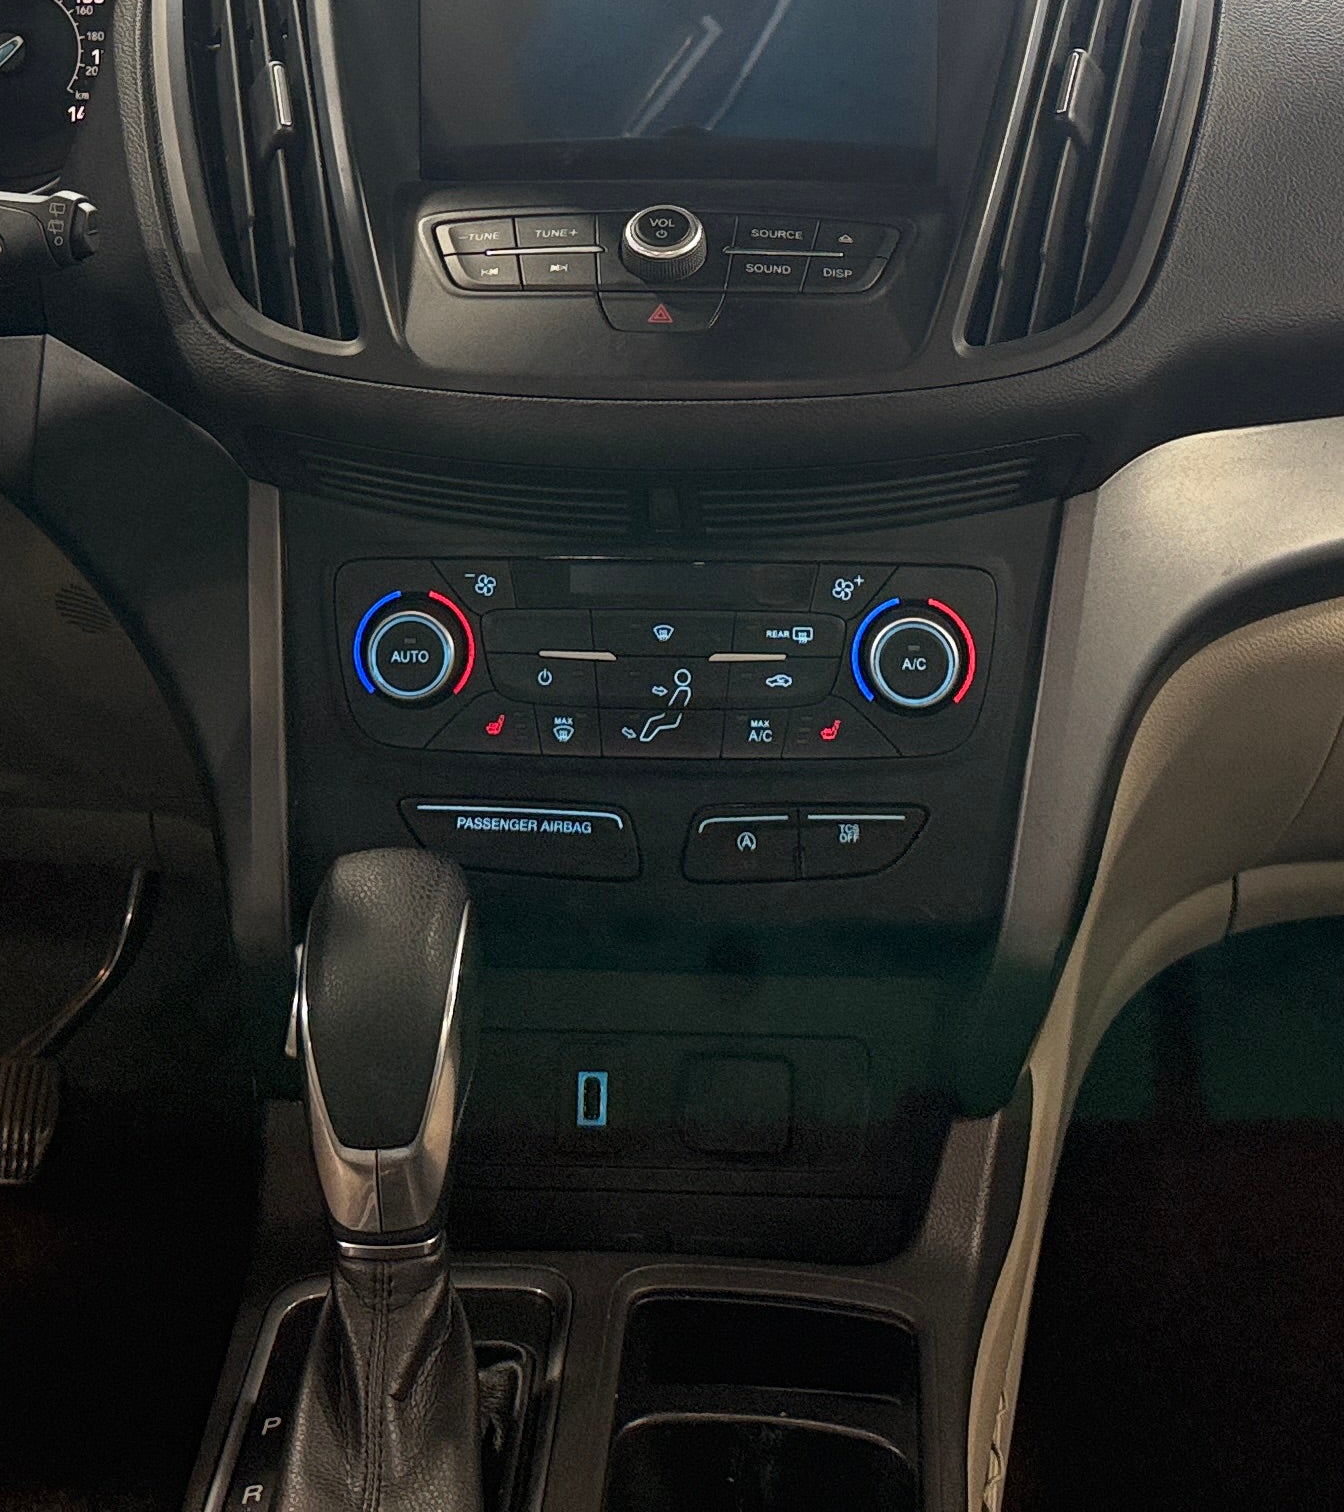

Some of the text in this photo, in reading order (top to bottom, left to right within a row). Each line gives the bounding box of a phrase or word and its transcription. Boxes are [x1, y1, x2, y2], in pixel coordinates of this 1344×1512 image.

[76, 5, 94, 16] 160
[87, 31, 105, 41] 180
[650, 218, 676, 229] VOL
[751, 228, 803, 241] SOURCE
[746, 263, 792, 276] SOUND
[823, 266, 853, 279] DISP
[765, 629, 790, 639] REAR
[391, 651, 430, 665] AUTO
[902, 658, 927, 671] A/C
[554, 716, 573, 726] MAX
[750, 719, 770, 728] MAX
[748, 729, 773, 743] A/C
[456, 817, 592, 834] PASSENGER AIRBAG
[838, 823, 860, 834] TCS
[839, 832, 860, 844] OFF
[261, 1416, 282, 1436] P
[241, 1484, 264, 1505] R
